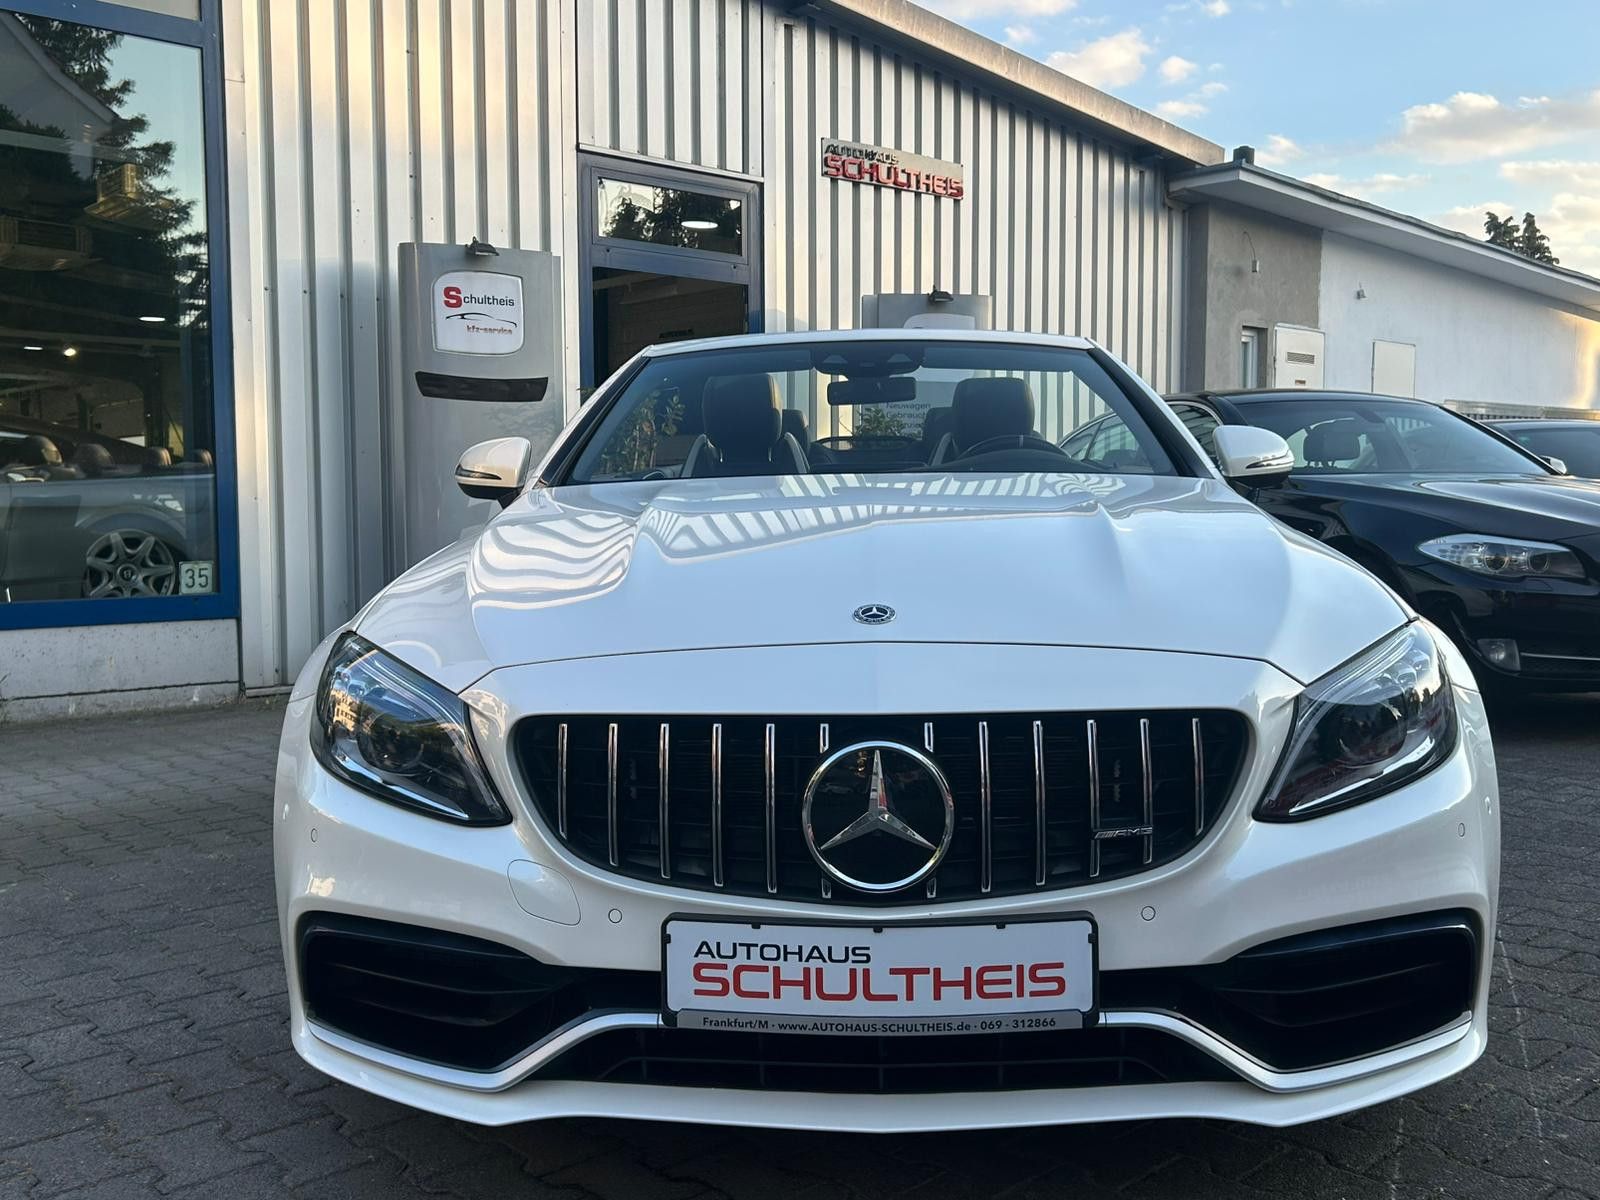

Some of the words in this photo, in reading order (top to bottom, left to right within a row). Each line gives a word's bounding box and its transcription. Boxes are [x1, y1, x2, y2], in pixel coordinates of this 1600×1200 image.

[825, 144, 898, 164] AUTOHAUS
[824, 155, 964, 197] SCHULTHEIS
[443, 286, 515, 308] Schultheis
[466, 325, 512, 334] kfz-service
[185, 567, 209, 589] 35
[693, 940, 871, 964] AUTOHAUS
[692, 962, 1066, 1002] SCHULTHEIS
[702, 1016, 769, 1030] Frankfurt/M
[777, 1021, 971, 1034] www.AUTOHAUS-SCHULTHEIS.de
[980, 1020, 1003, 1031] 069
[1012, 1017, 1057, 1030] 312866
